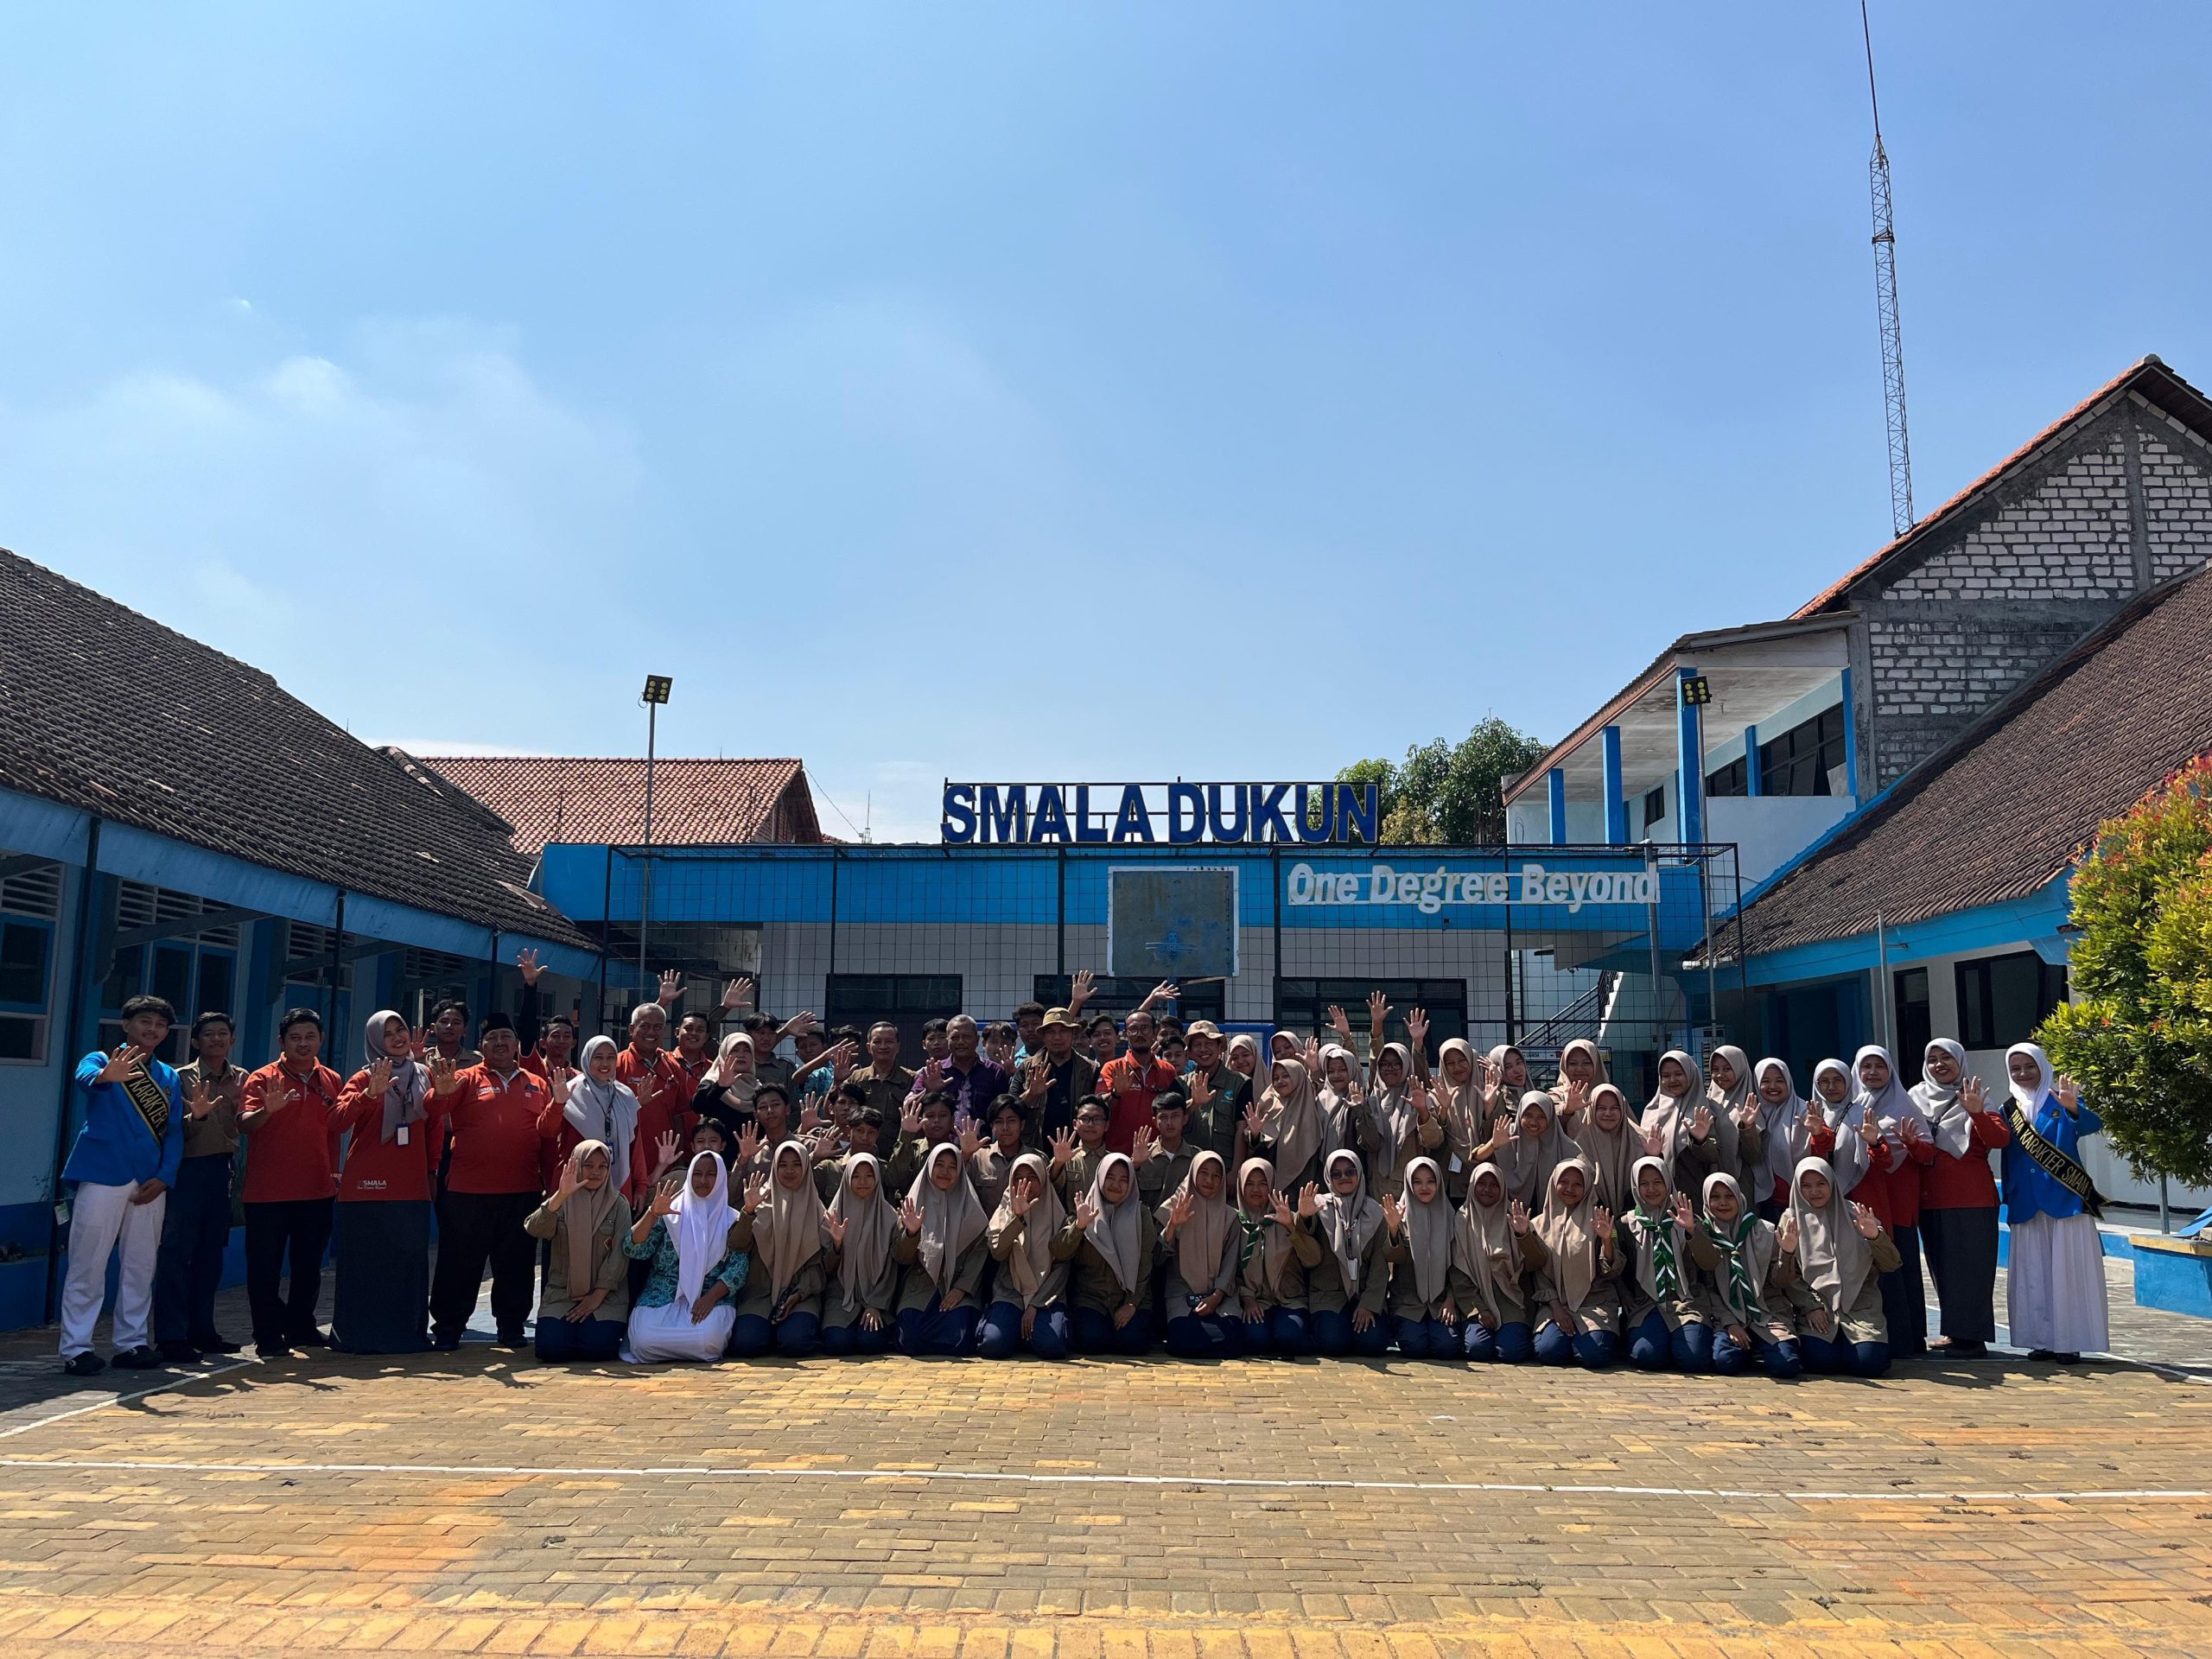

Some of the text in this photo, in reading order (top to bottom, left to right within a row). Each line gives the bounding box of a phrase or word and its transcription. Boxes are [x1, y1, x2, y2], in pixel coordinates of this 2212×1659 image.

[940, 783, 1378, 845] SMALA DUKUN
[1288, 862, 1657, 914] One Degree Beyond
[129, 1077, 168, 1128] KARAKTER
[2019, 1128, 2066, 1174] KARAKTER
